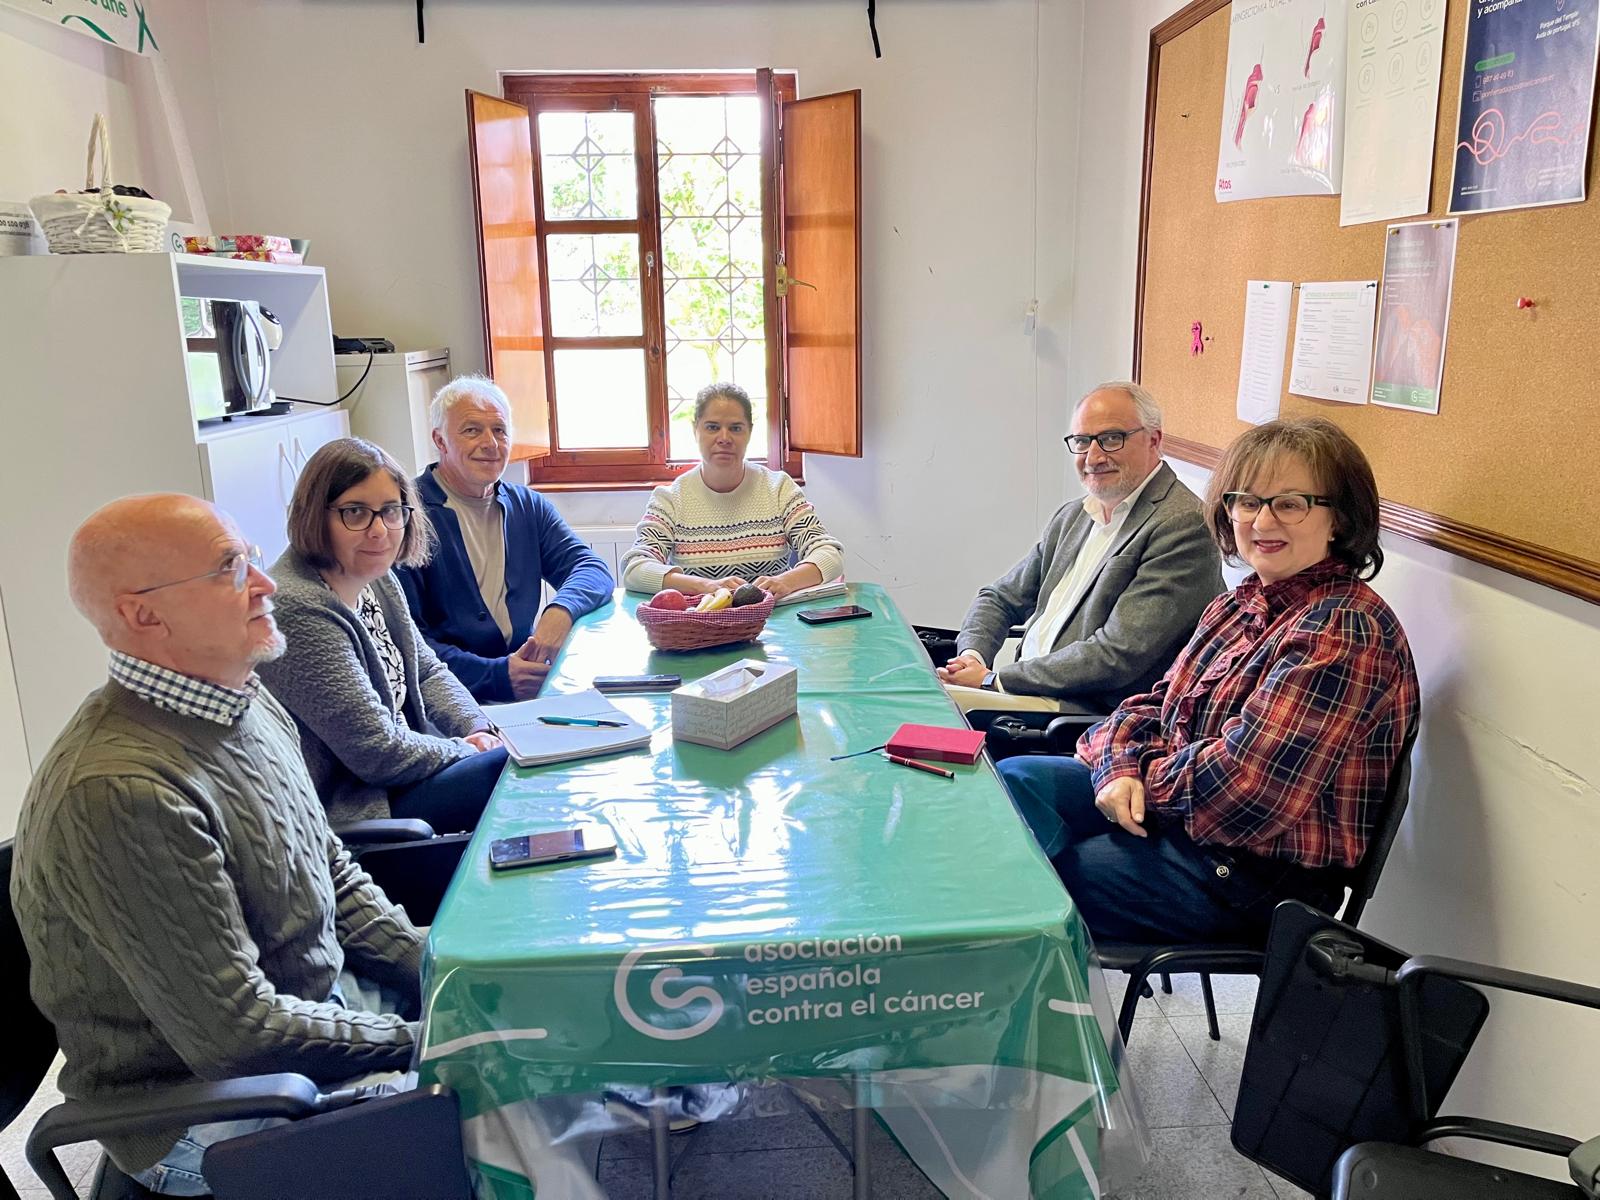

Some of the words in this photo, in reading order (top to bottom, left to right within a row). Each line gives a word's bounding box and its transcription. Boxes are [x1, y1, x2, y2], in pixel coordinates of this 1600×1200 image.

[1477, 8, 1484, 19] y
[744, 932, 902, 963] asociación
[746, 963, 881, 999] española
[748, 999, 843, 1026] contra
[850, 993, 876, 1016] el
[884, 990, 985, 1014] cáncer
